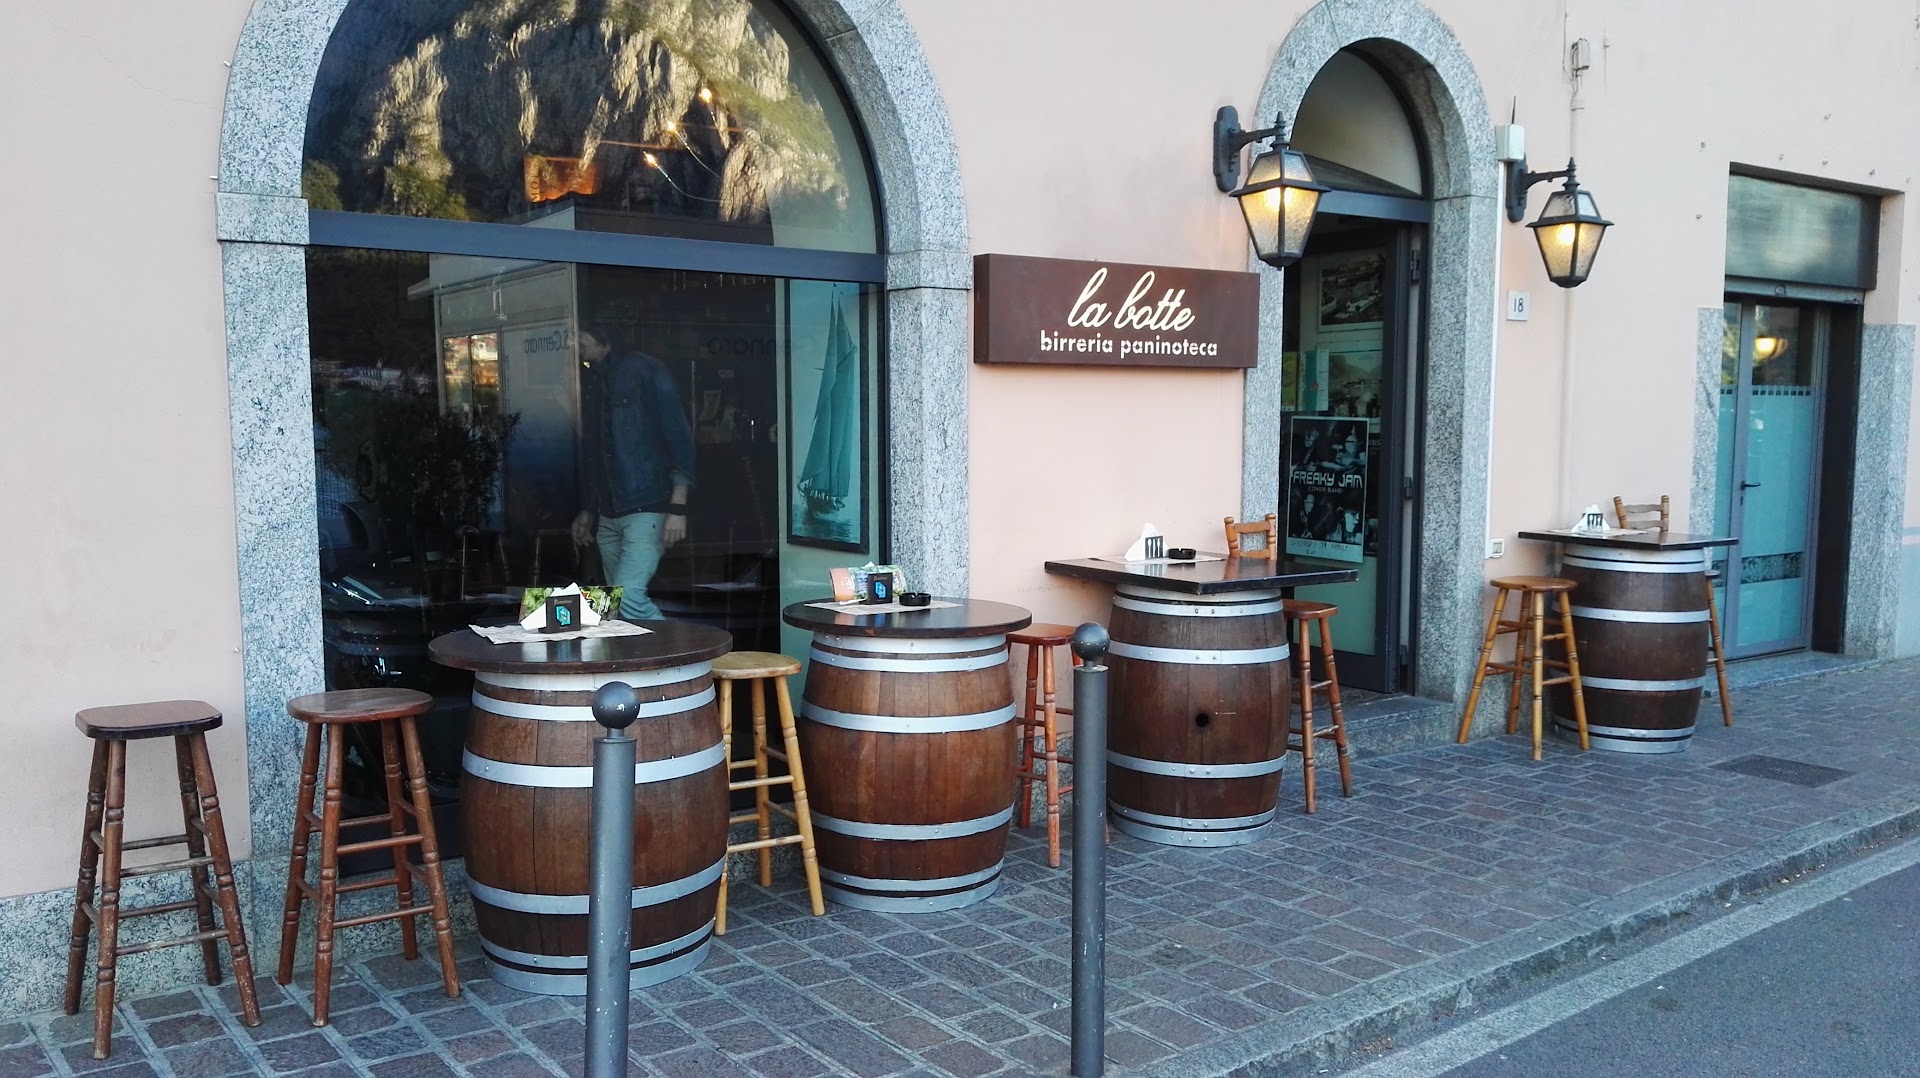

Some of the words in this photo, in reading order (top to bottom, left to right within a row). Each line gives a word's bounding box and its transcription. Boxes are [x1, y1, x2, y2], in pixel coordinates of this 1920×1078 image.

[1067, 267, 1112, 328] la
[1113, 270, 1196, 332] botte
[1513, 298, 1524, 312] 18
[1040, 330, 1113, 353] birreria
[1120, 334, 1218, 359] paninoteca
[1293, 470, 1335, 487] FREAKY
[1338, 473, 1363, 489] JAM
